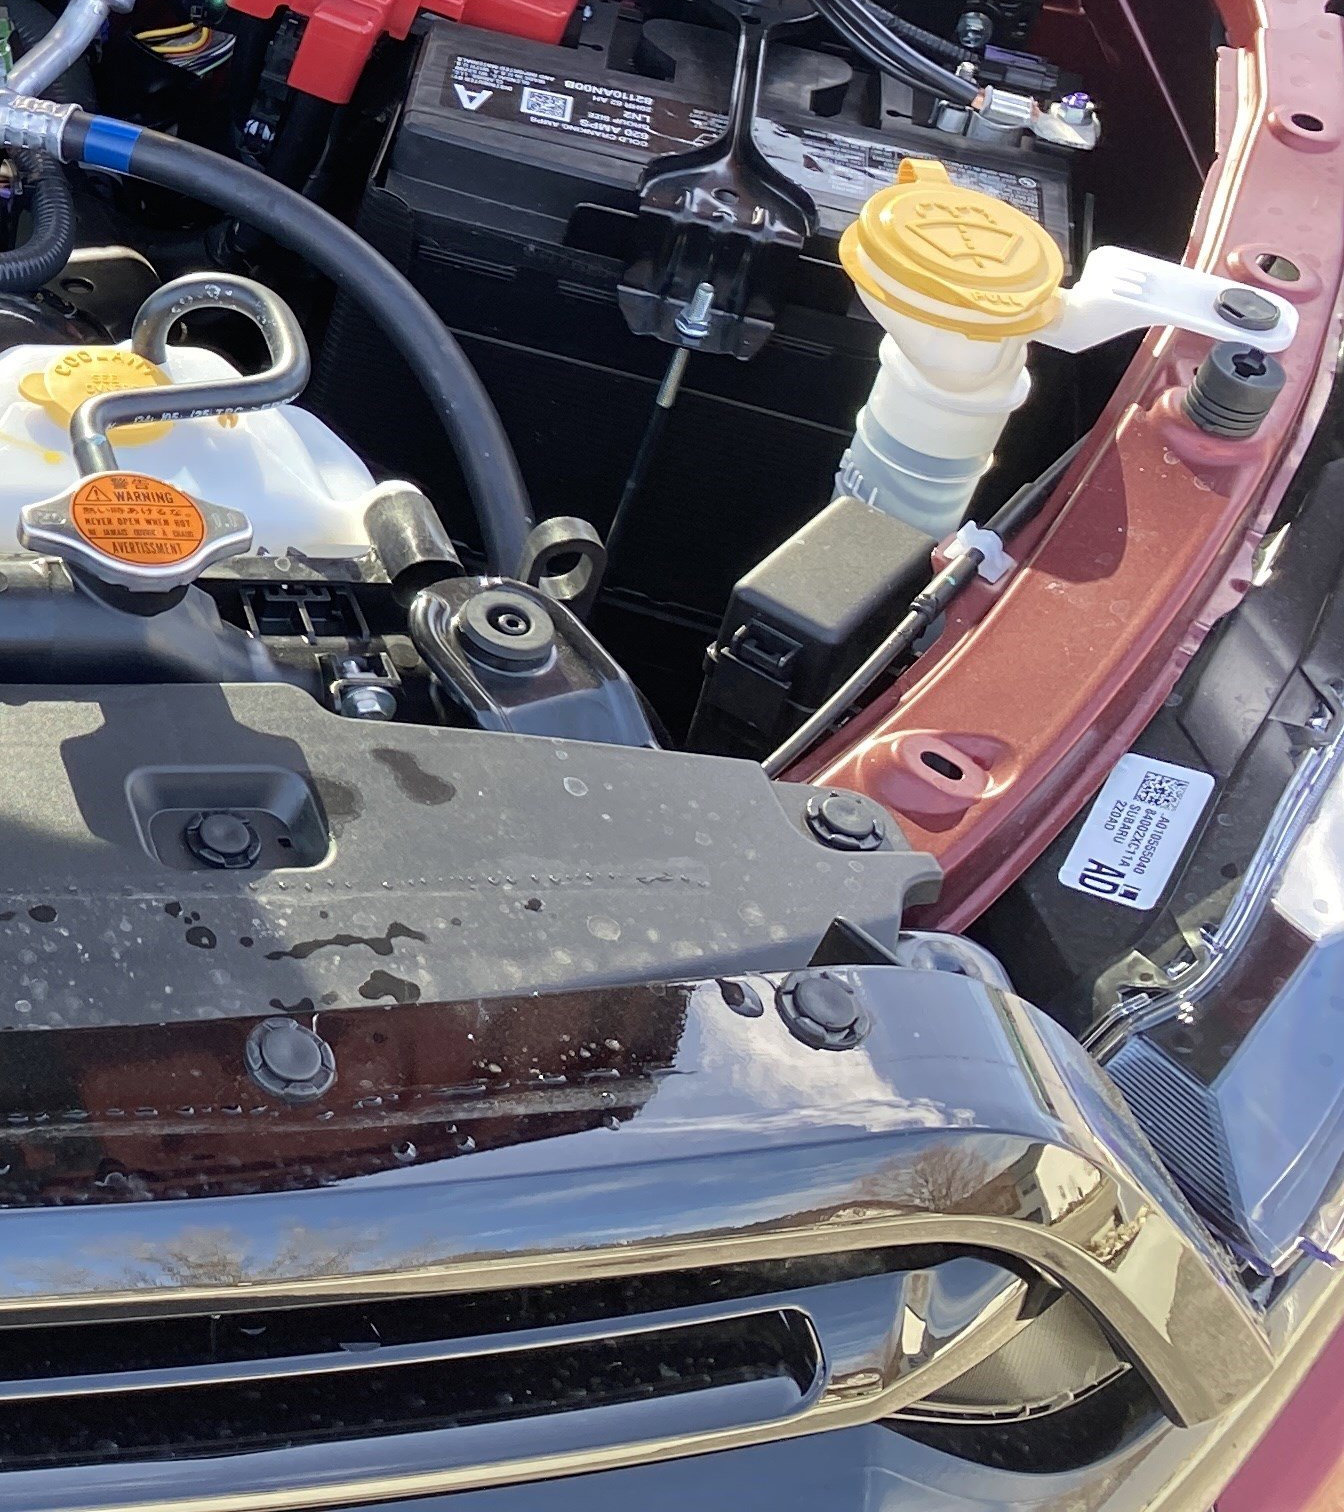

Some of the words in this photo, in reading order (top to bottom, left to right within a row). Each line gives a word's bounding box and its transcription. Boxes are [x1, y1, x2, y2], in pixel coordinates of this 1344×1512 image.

[530, 116, 560, 128] AMPS
[623, 110, 650, 123] LN2
[561, 123, 617, 141] CRANKING
[579, 118, 621, 134] AMPS
[618, 136, 649, 148] COLD
[113, 491, 174, 504] WARNING
[84, 517, 112, 526] NEVER
[117, 517, 140, 526] OPEN
[144, 518, 170, 527] WHEN
[1113, 804, 1141, 845] SUBARU
[1118, 808, 1157, 868] 84002XC11A
[1078, 857, 1127, 895] AD
